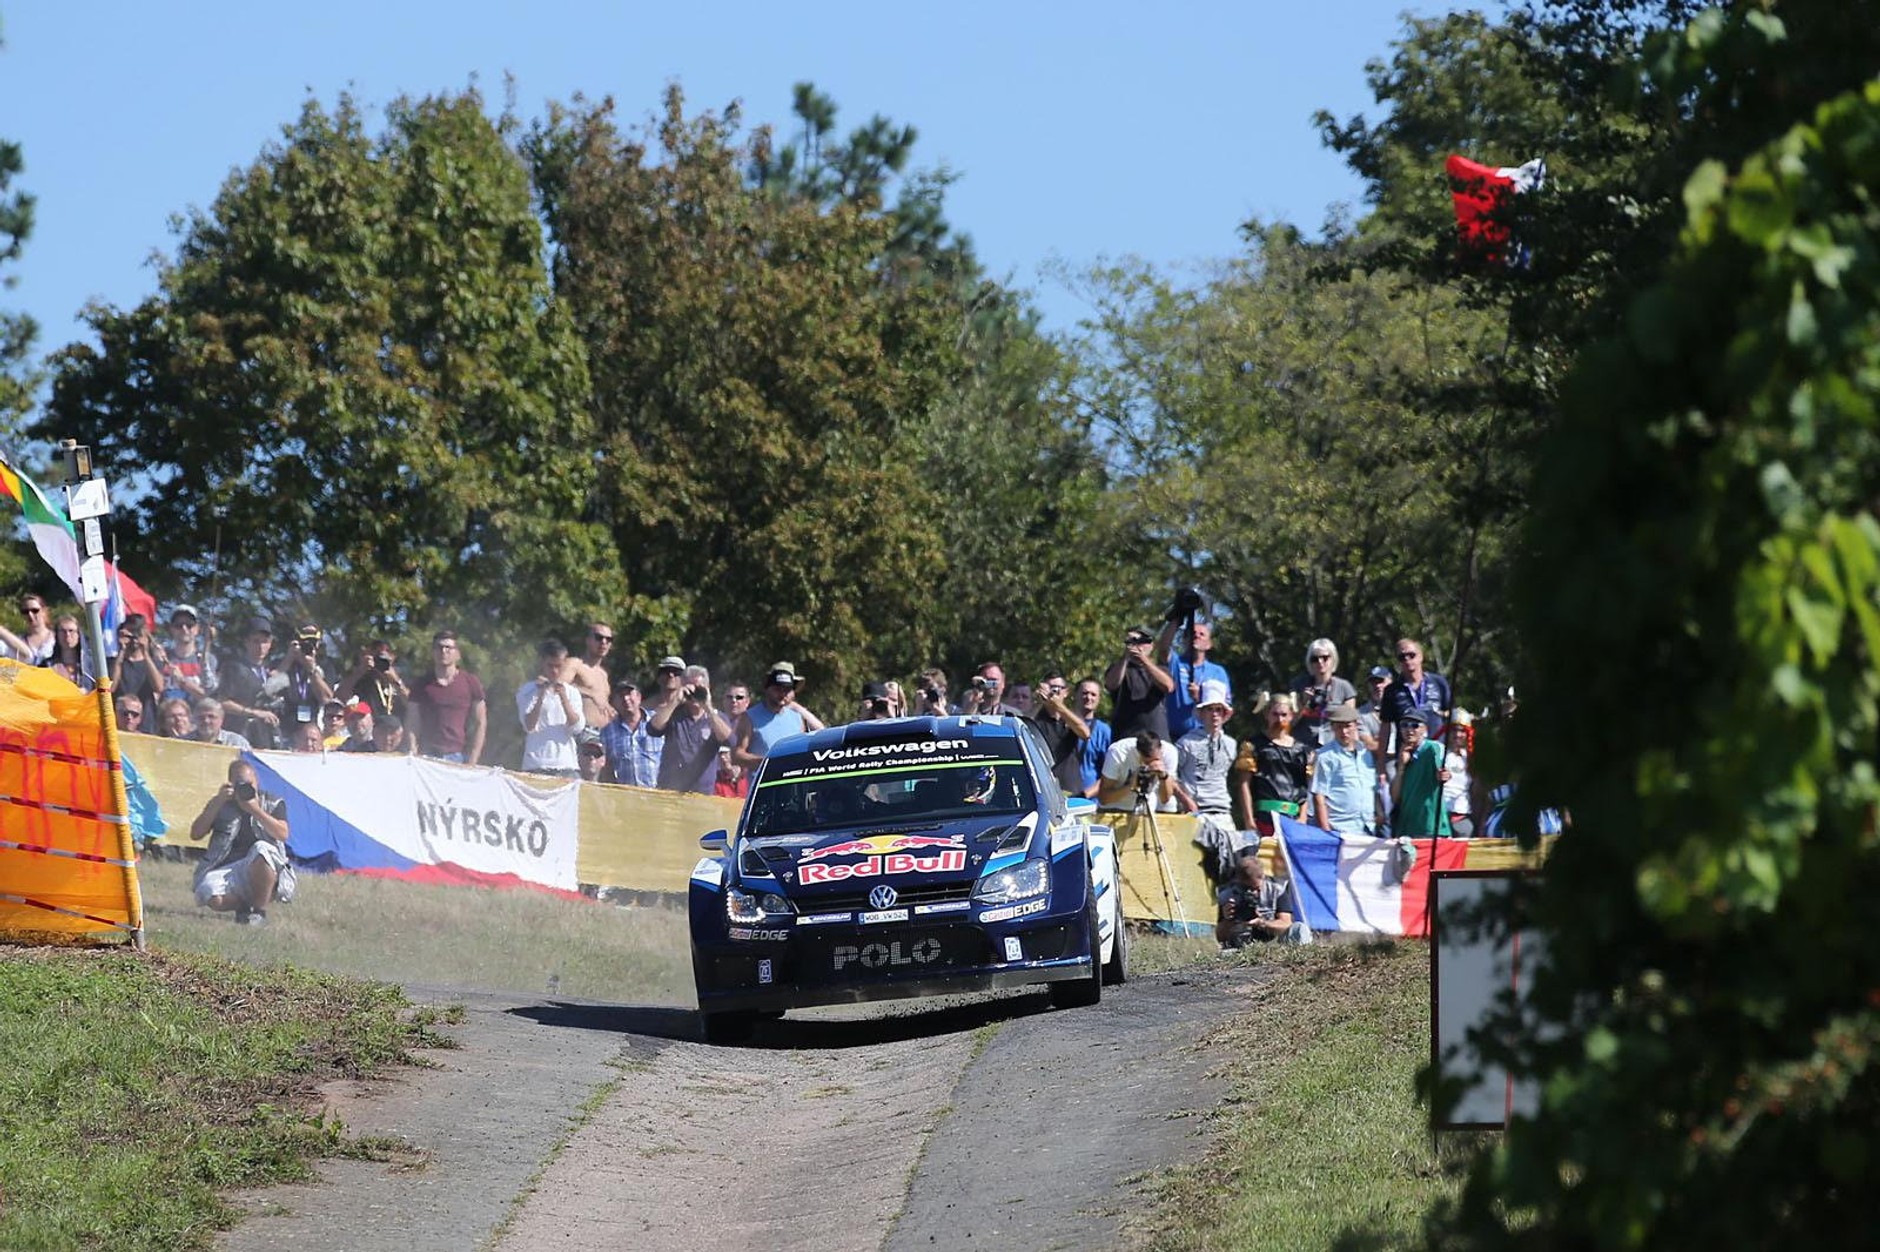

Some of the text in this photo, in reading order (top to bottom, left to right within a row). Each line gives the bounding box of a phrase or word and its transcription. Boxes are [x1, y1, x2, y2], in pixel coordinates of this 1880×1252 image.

[813, 740, 968, 761] Volkswagen
[810, 767, 825, 776] FIA
[828, 764, 856, 772] World
[859, 760, 883, 770] Rally
[886, 754, 954, 766] Championship
[417, 798, 549, 858] NÝRSKO
[799, 851, 965, 884] Red Bull
[1014, 898, 1046, 917] EDGE
[752, 929, 789, 940] EDGE
[834, 938, 941, 970] POLO
